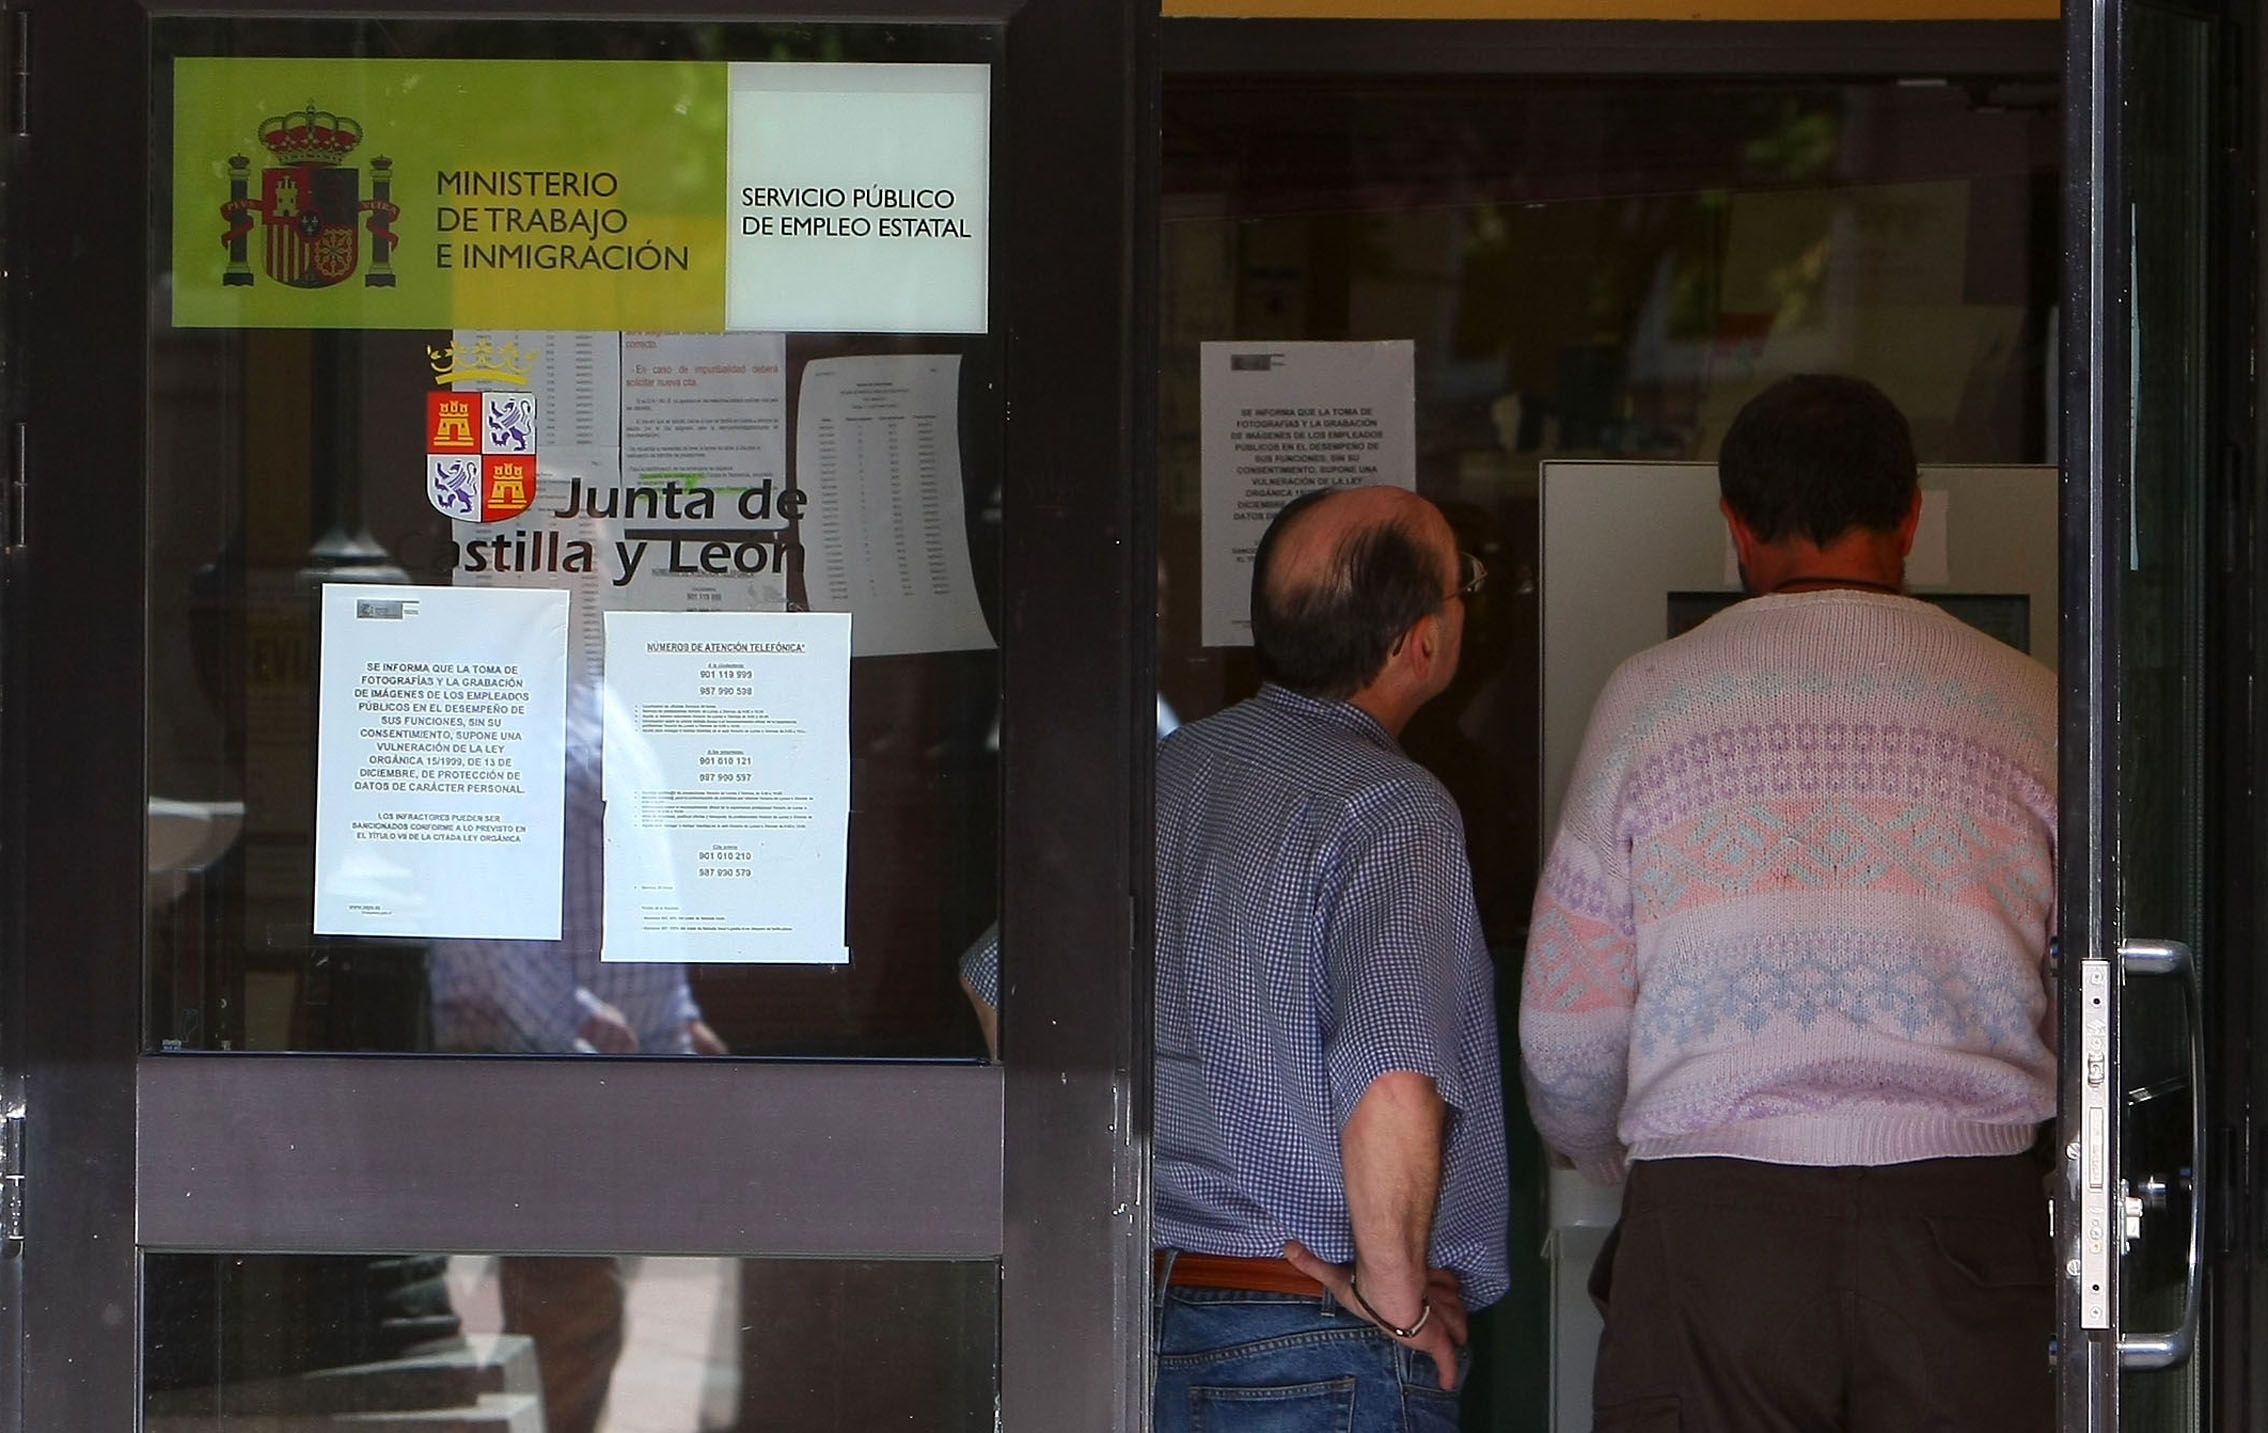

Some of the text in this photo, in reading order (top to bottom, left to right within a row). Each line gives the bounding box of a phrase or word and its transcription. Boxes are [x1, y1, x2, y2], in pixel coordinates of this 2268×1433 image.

[437, 171, 618, 198] MINISTERIO
[741, 181, 955, 209] SERVICIO PÚBLICO
[437, 208, 628, 240] DE TRABAJO
[742, 216, 972, 240] DE EMPLEO ESTATAL
[437, 240, 690, 271] E INMIGRACIÓN
[1241, 408, 1373, 417] SE INFORMA QUE LA TOMA DE
[555, 477, 714, 521] Junta
[738, 477, 807, 520] de
[614, 537, 649, 586] y
[647, 641, 689, 653] NÚMEROS
[691, 643, 704, 652] DE
[705, 641, 748, 653] ATENCIÓN
[367, 662, 518, 674] SE INFORMA QUE LA TOMA DE
[361, 675, 523, 687] FOTOGRAFÍAS Y LA GRABACIÓN
[700, 671, 716, 679] 901
[354, 688, 529, 701] DE IMÁGENES DE LOS EMPLEADOS
[359, 701, 525, 714] PÚBLICOS EN EL DESEMPEÑO DE
[381, 716, 502, 727] SUS FUNCIONES, SIN SU
[360, 729, 522, 741] CONSENTIMIENTO, SUPONE UNA
[377, 742, 504, 754] VULNERACIÓN DE LA LEY
[369, 755, 424, 765] ORGÁNICA
[468, 757, 481, 766] DE
[498, 758, 512, 767] DE
[699, 757, 716, 765] 901
[737, 757, 751, 765] 121
[360, 768, 521, 780] DICIEMBRE, DE PROTECCIÓN DE
[354, 782, 389, 791] DATOS
[392, 782, 406, 791] DE
[409, 781, 465, 792] CARÁCTER
[718, 852, 734, 861] 010
[735, 852, 751, 861] 210
